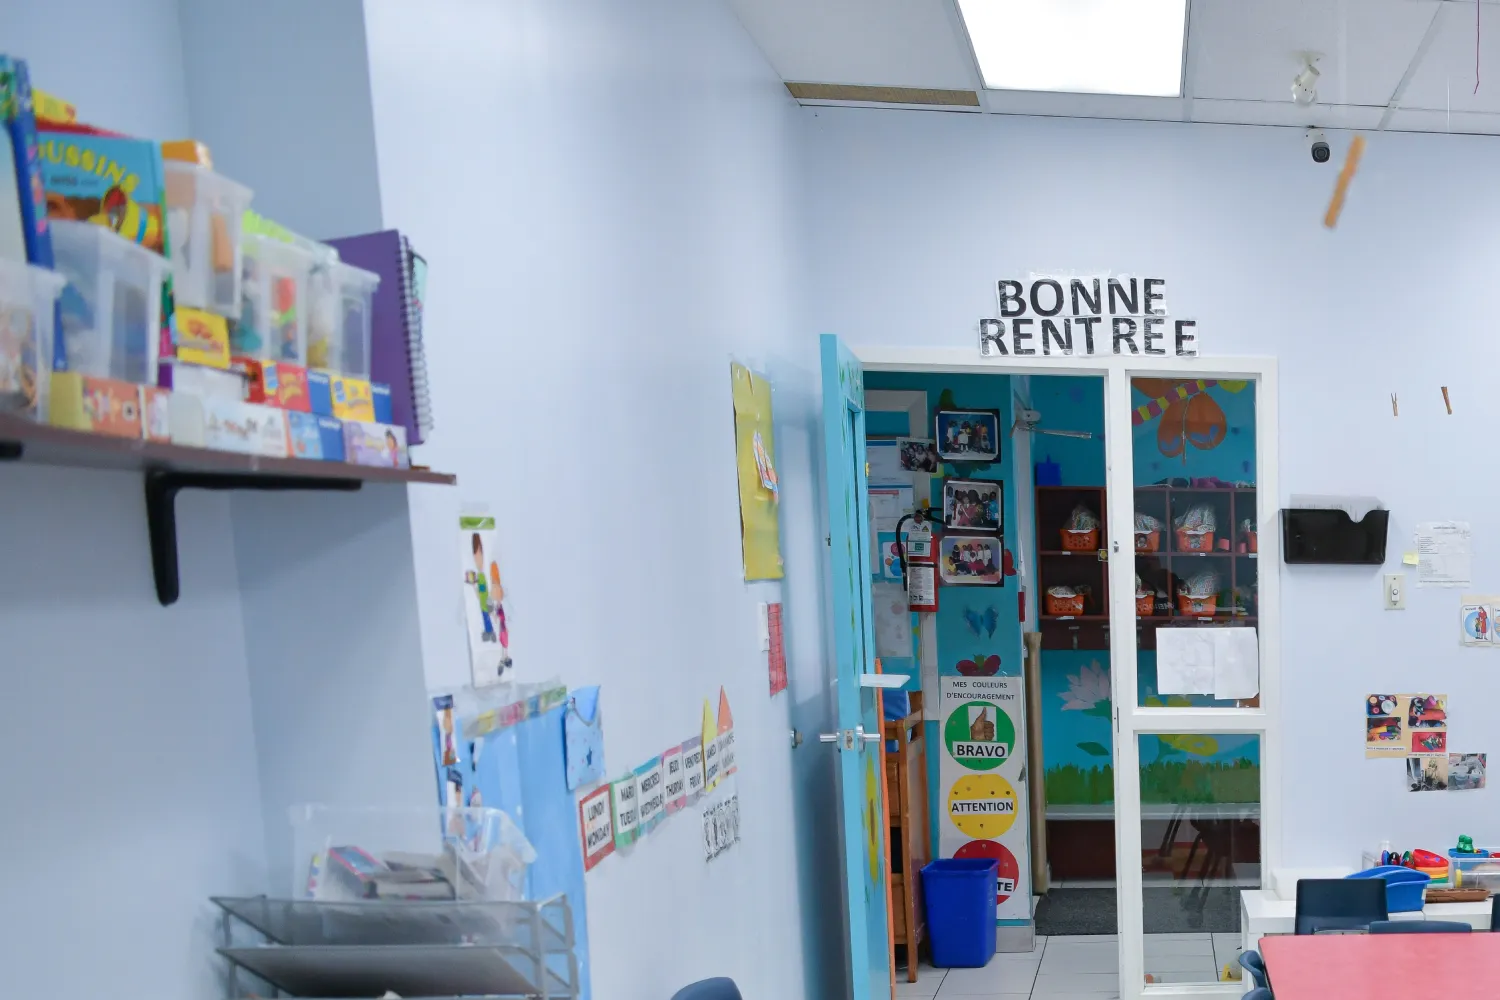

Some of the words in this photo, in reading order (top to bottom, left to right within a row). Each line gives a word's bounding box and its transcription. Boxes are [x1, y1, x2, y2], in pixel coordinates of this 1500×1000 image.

[998, 278, 1165, 317] BONNE
[980, 317, 1197, 356] RENTREE
[972, 681, 1008, 689] COULEURS
[946, 692, 1015, 701] D'ENCOURAGEMENT
[956, 744, 1006, 758] BRAVO
[588, 800, 605, 822] LUNDI
[951, 802, 1014, 813] ATTENTION
[587, 823, 610, 849] MONDAY
